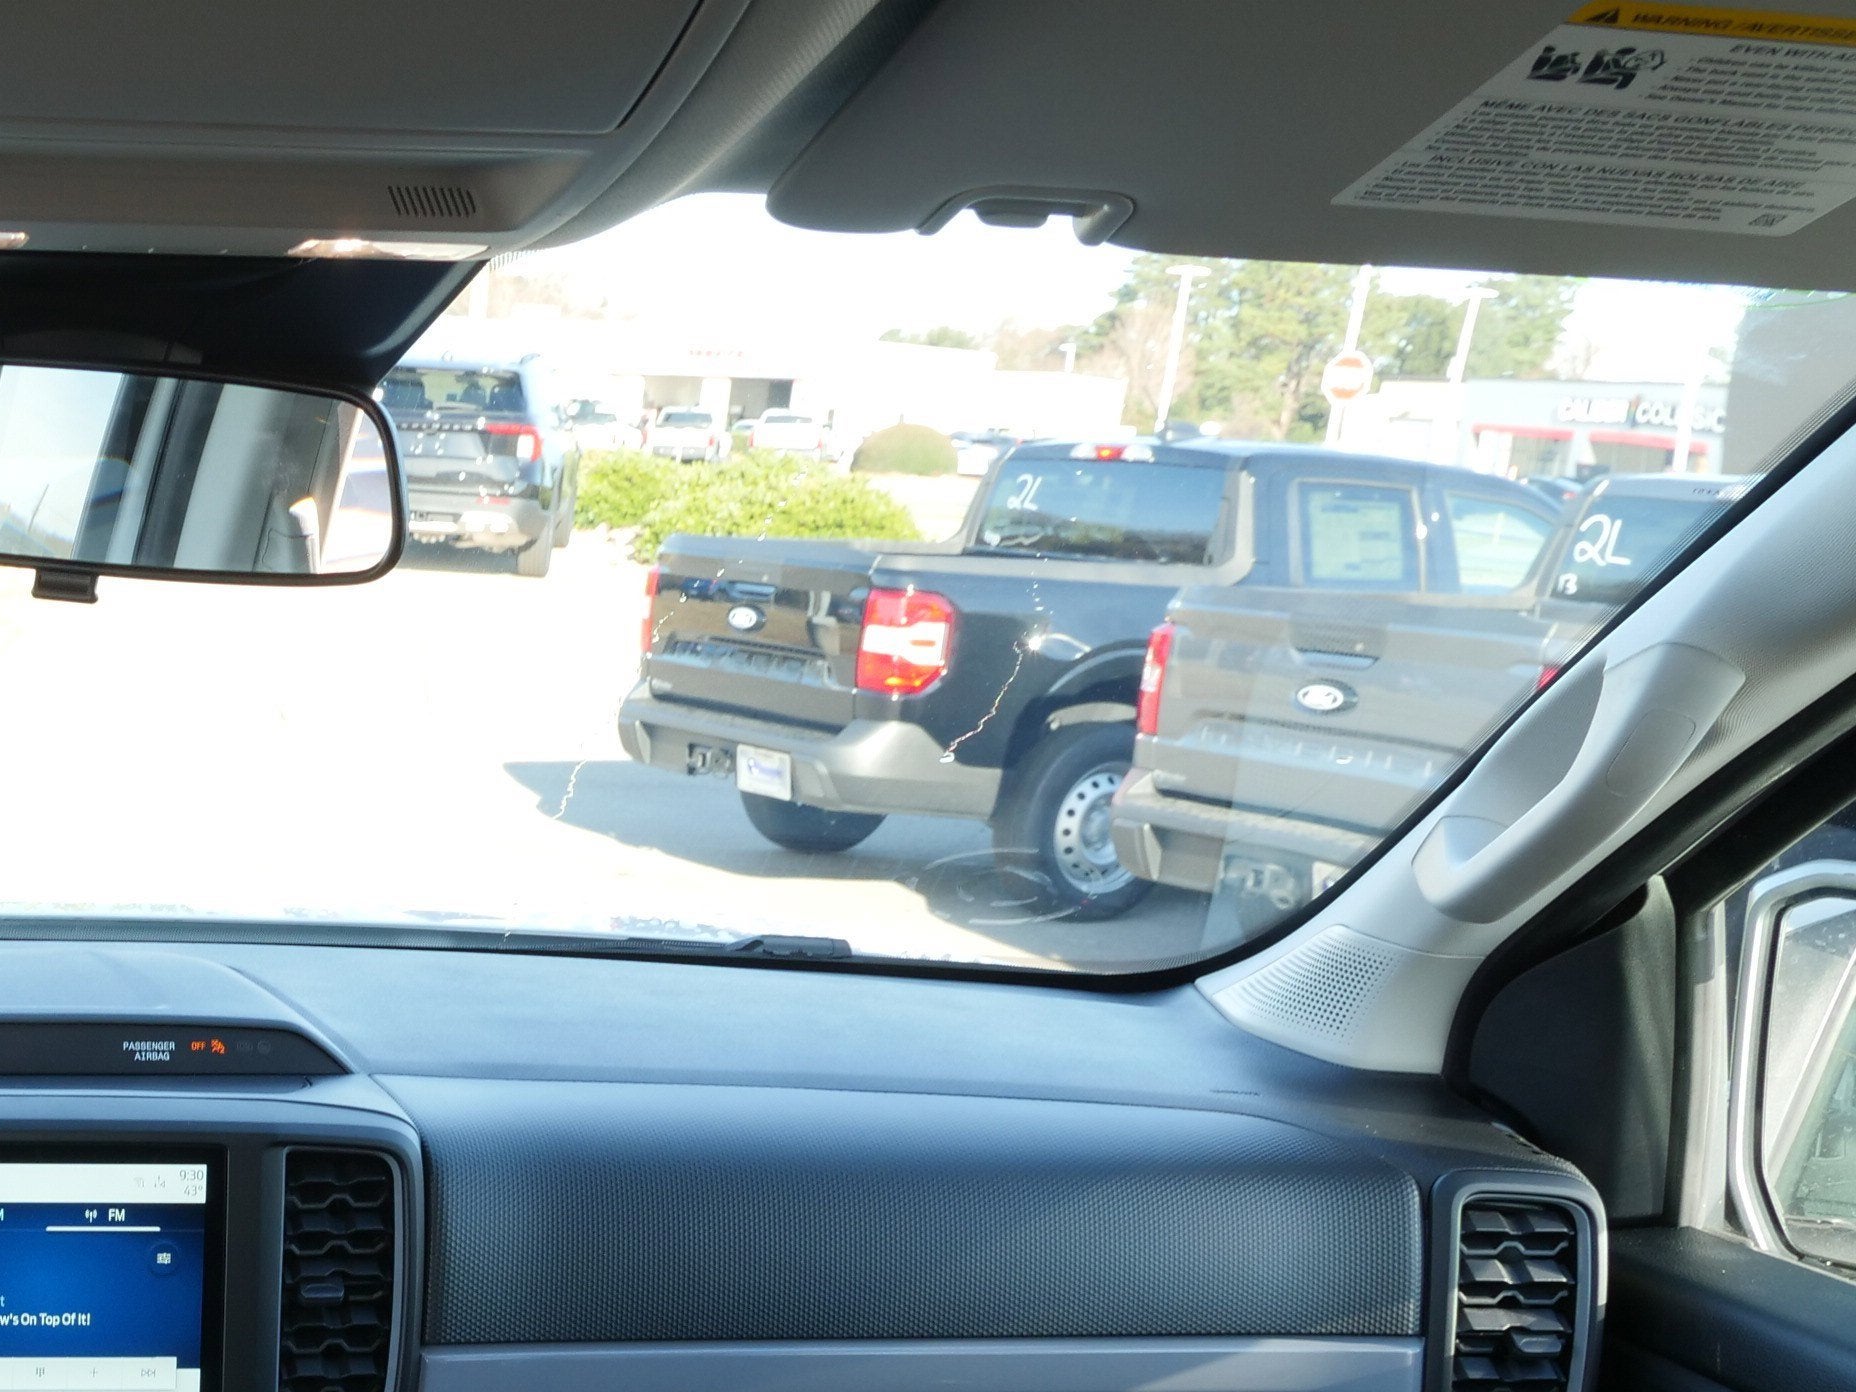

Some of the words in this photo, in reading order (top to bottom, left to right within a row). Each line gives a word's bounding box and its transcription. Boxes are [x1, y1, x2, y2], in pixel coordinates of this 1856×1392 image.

[1573, 514, 1632, 566] 2L
[123, 1041, 175, 1051] PASSENGER
[191, 1042, 207, 1051] OFF
[134, 1052, 170, 1062] AIRBAG
[179, 1170, 204, 1182] 9:30
[108, 1208, 125, 1222] FM
[21, 1313, 37, 1326] On
[39, 1313, 60, 1328] Top
[61, 1312, 76, 1326] Of
[78, 1312, 91, 1326] It!
